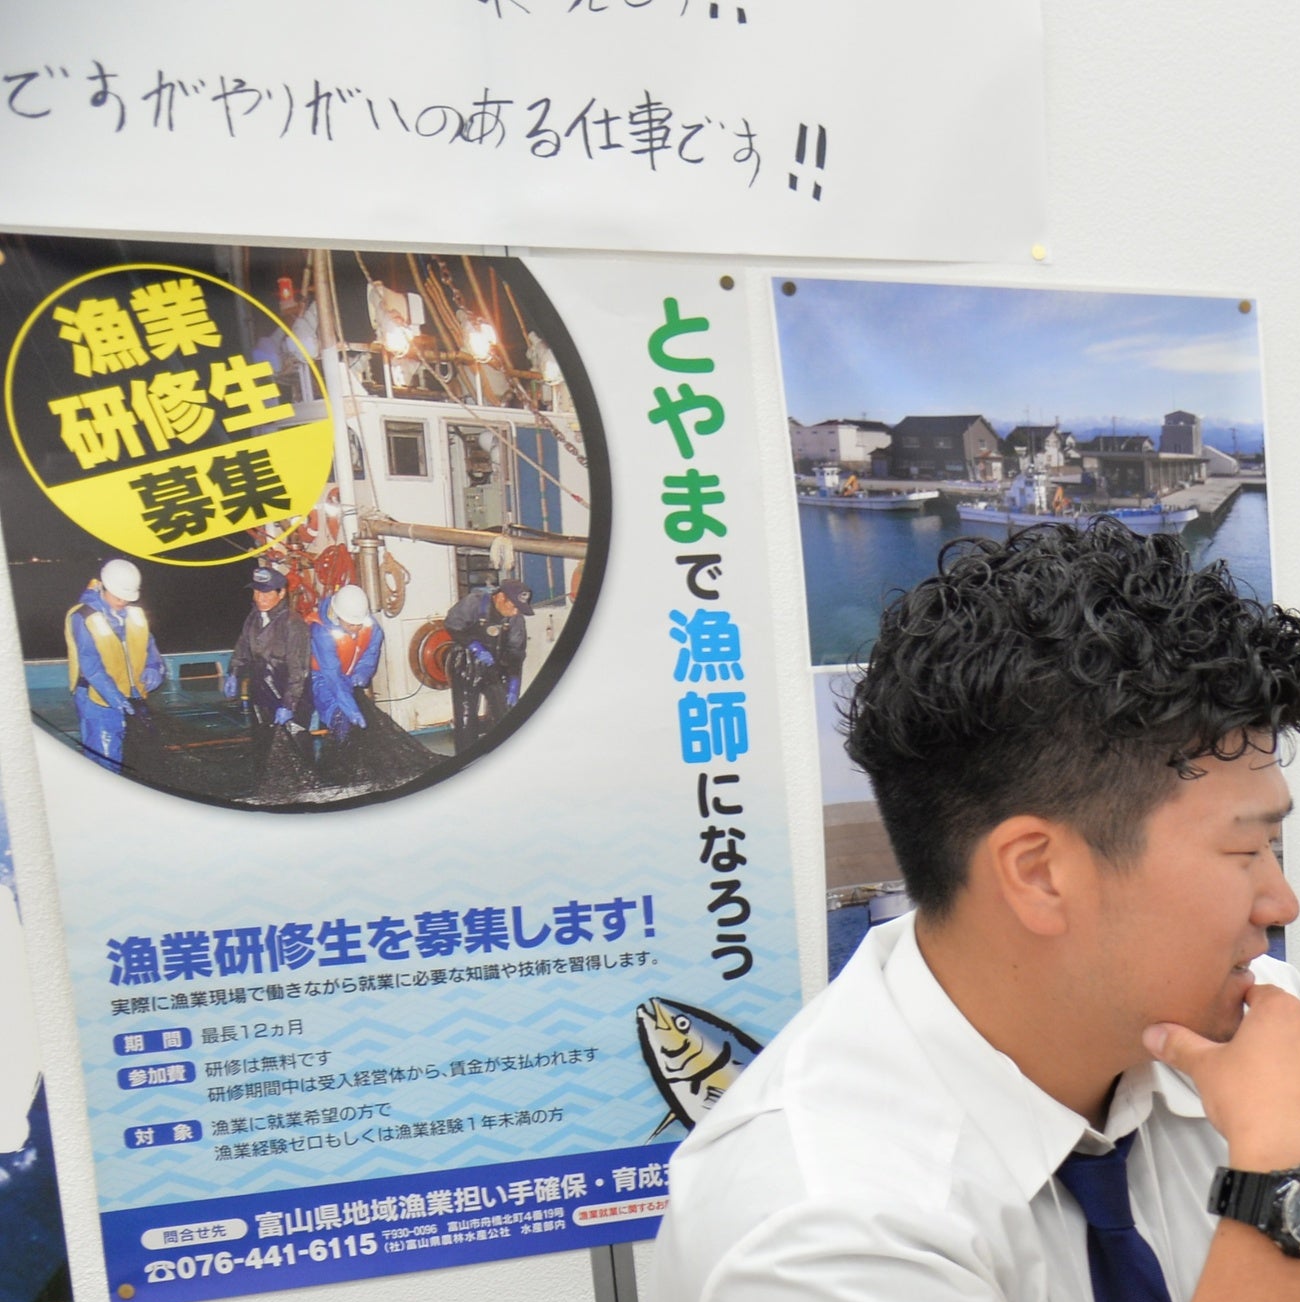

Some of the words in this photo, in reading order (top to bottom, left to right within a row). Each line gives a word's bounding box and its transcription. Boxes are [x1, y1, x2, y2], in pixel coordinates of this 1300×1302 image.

[52, 278, 222, 378] 漁業
[47, 354, 295, 470] 研修生
[128, 448, 291, 544] 募集
[646, 296, 754, 981] とやまで漁師になろう
[105, 894, 656, 986] 漁業研修生を募集します!
[111, 951, 659, 1016] 実際に漁業現場で働きながら就業に必要な知識や技術を習得します。
[127, 1064, 187, 1087] 参加費
[204, 1049, 333, 1079] 研修は無料です
[206, 1047, 600, 1103] 研修期間中は受入経営体から、賃金が支払われます
[210, 1101, 392, 1138] 漁業に就業希望の方で
[254, 1163, 670, 1240] 富山県地域漁業担い手確保・育成
[520, 1217, 567, 1236] 水産部内
[162, 1224, 227, 1245] 問合せ先
[177, 1232, 379, 1280] 076-441-6115
